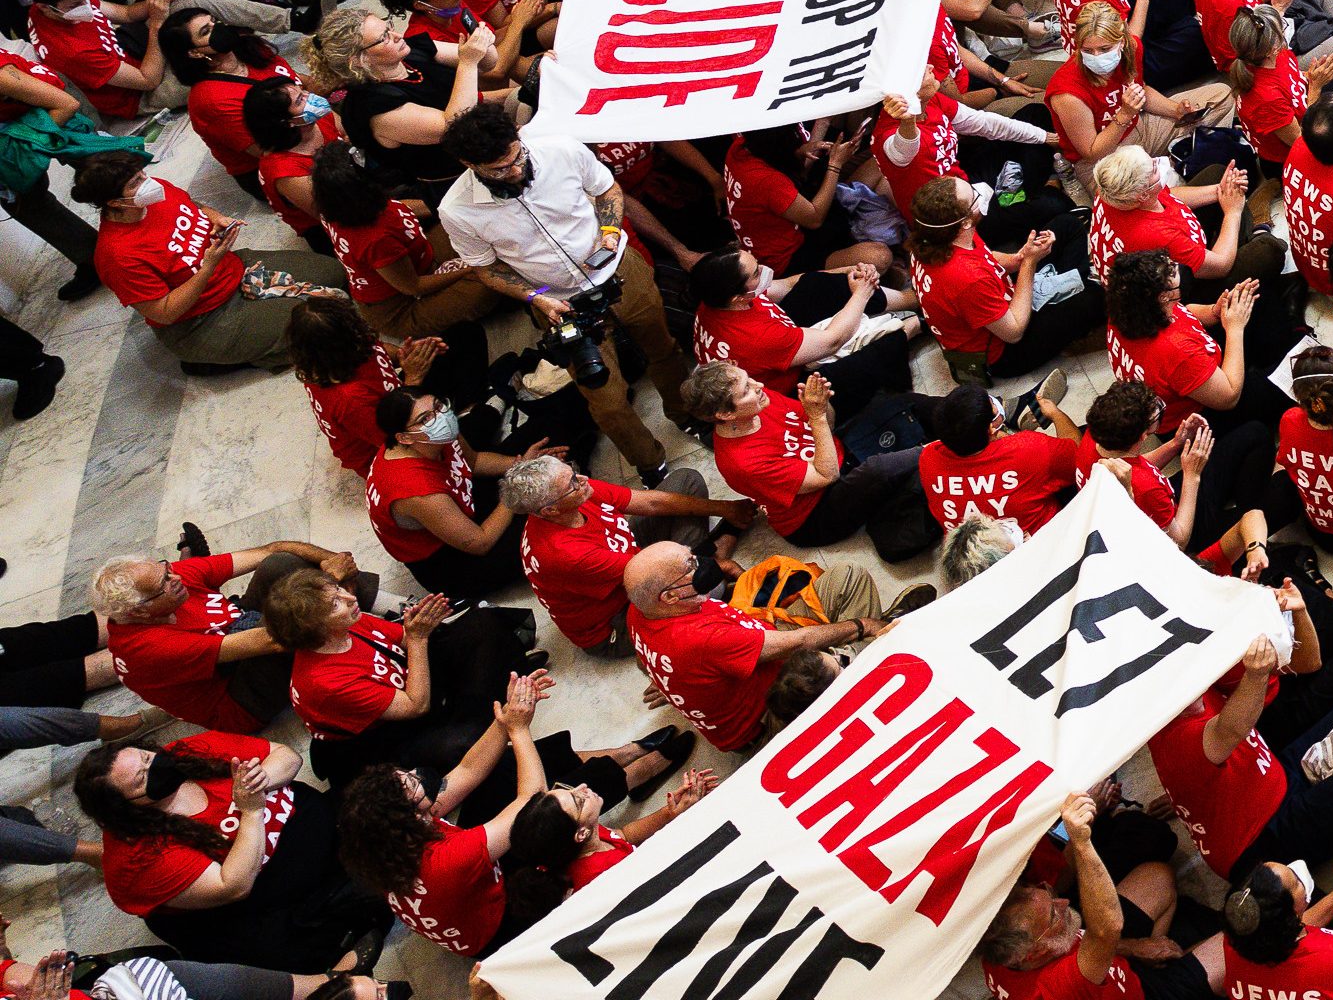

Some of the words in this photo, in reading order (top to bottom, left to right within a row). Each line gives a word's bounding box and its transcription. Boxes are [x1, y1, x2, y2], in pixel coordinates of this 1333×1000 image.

[766, 28, 872, 112] THE
[1283, 163, 1333, 212] JEWS
[1283, 185, 1322, 225] SAY
[168, 203, 194, 254] STOP
[932, 470, 1018, 496] JEWS
[942, 495, 1010, 520] SAY
[970, 530, 1213, 719] LET
[761, 653, 1053, 928] GAZA
